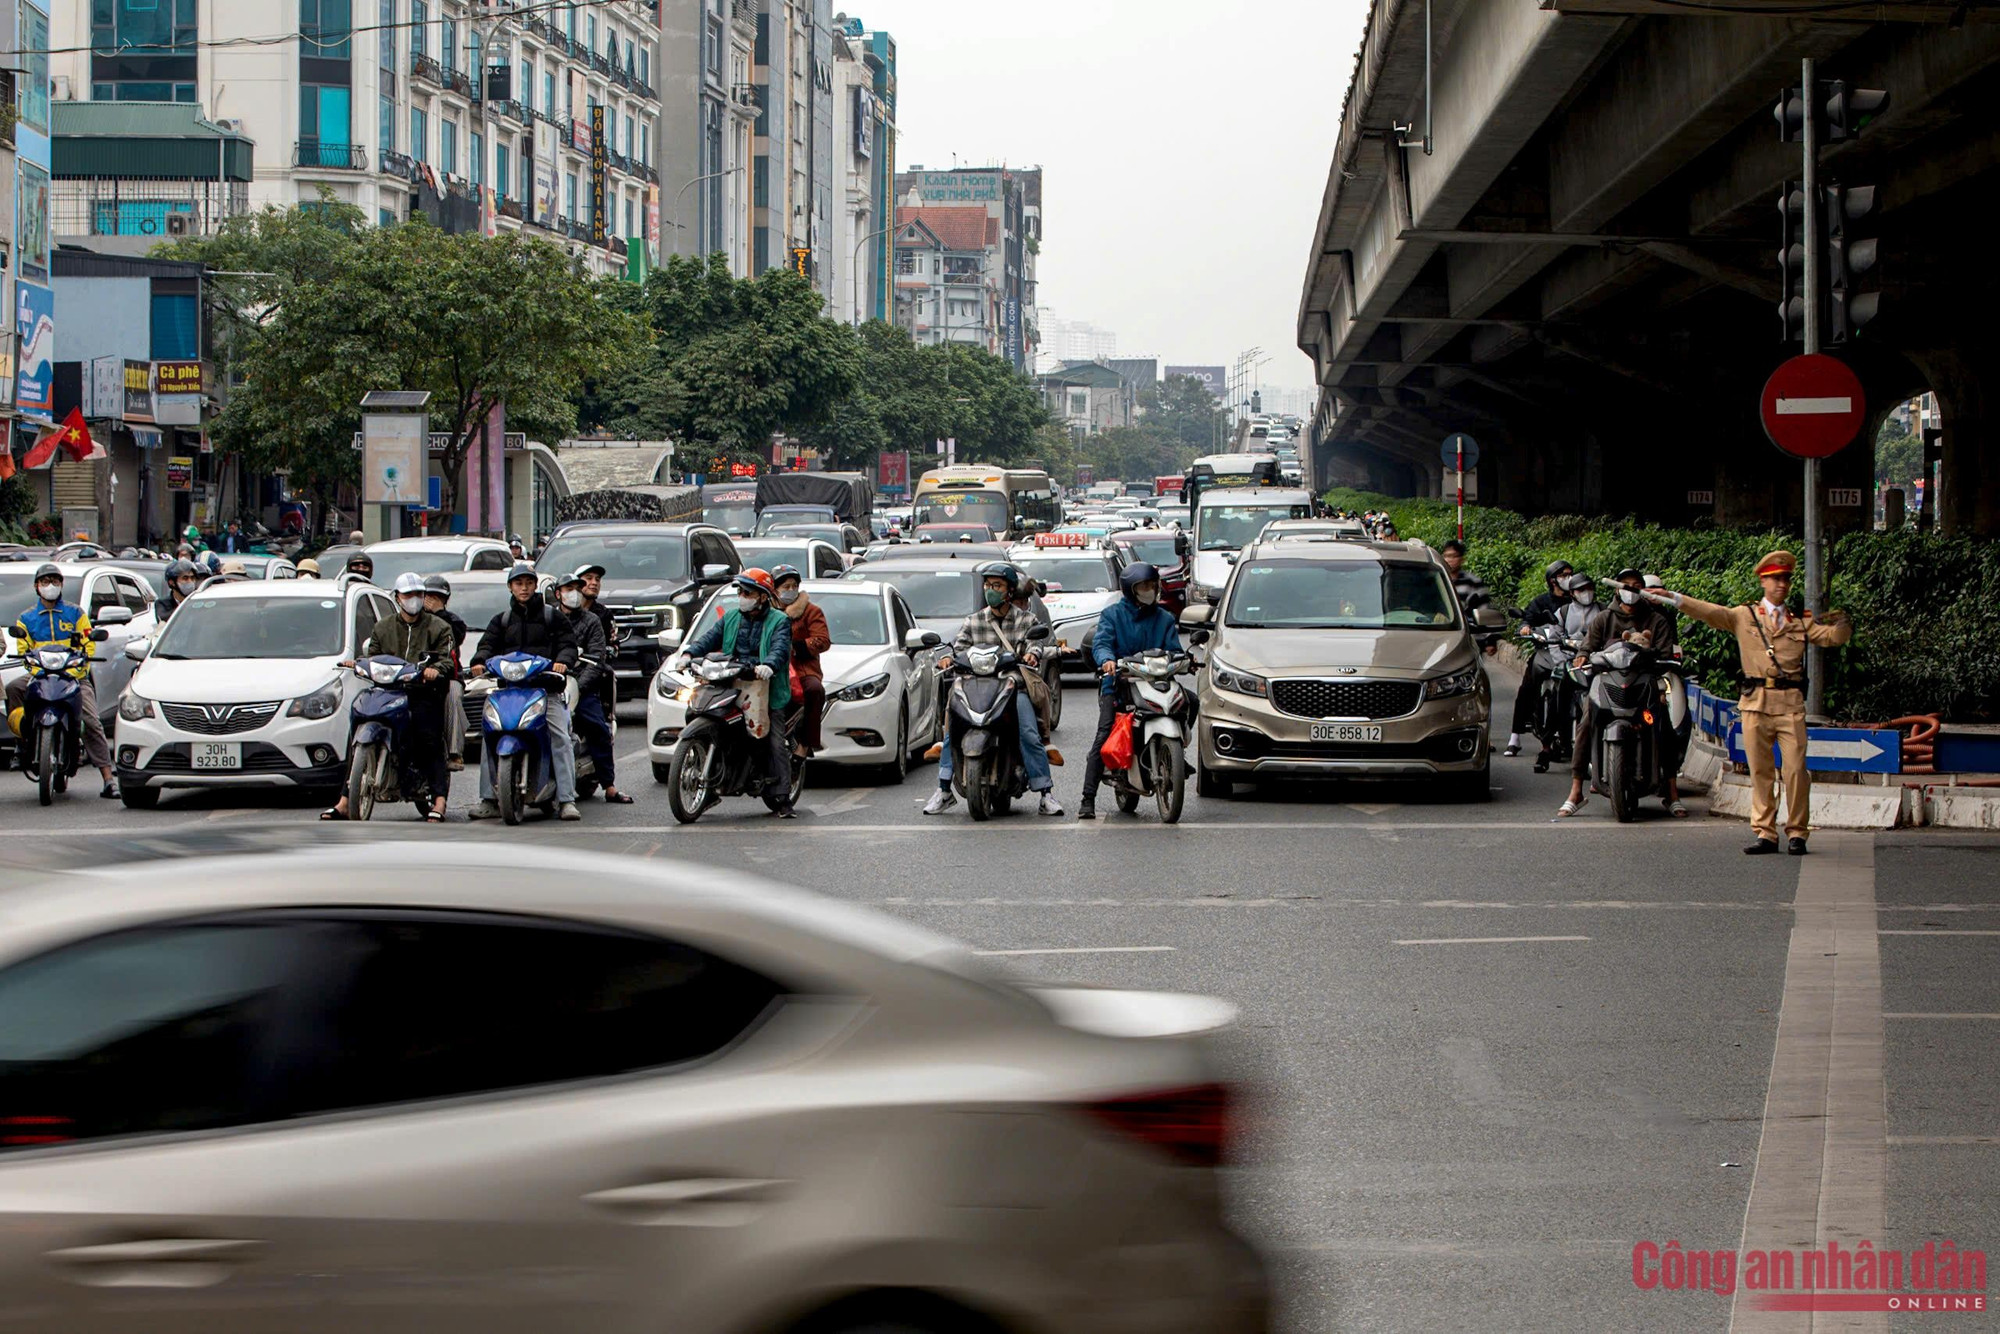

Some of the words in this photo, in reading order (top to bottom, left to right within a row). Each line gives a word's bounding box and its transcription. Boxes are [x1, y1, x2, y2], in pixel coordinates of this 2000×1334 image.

[160, 365, 175, 379] Cà
[178, 364, 199, 380] phê
[1831, 490, 1858, 504] T175
[1037, 534, 1059, 545] Taxi
[1062, 534, 1085, 545] 123
[59, 619, 74, 632] be
[205, 744, 228, 755] 30H
[197, 756, 236, 767] 923.80
